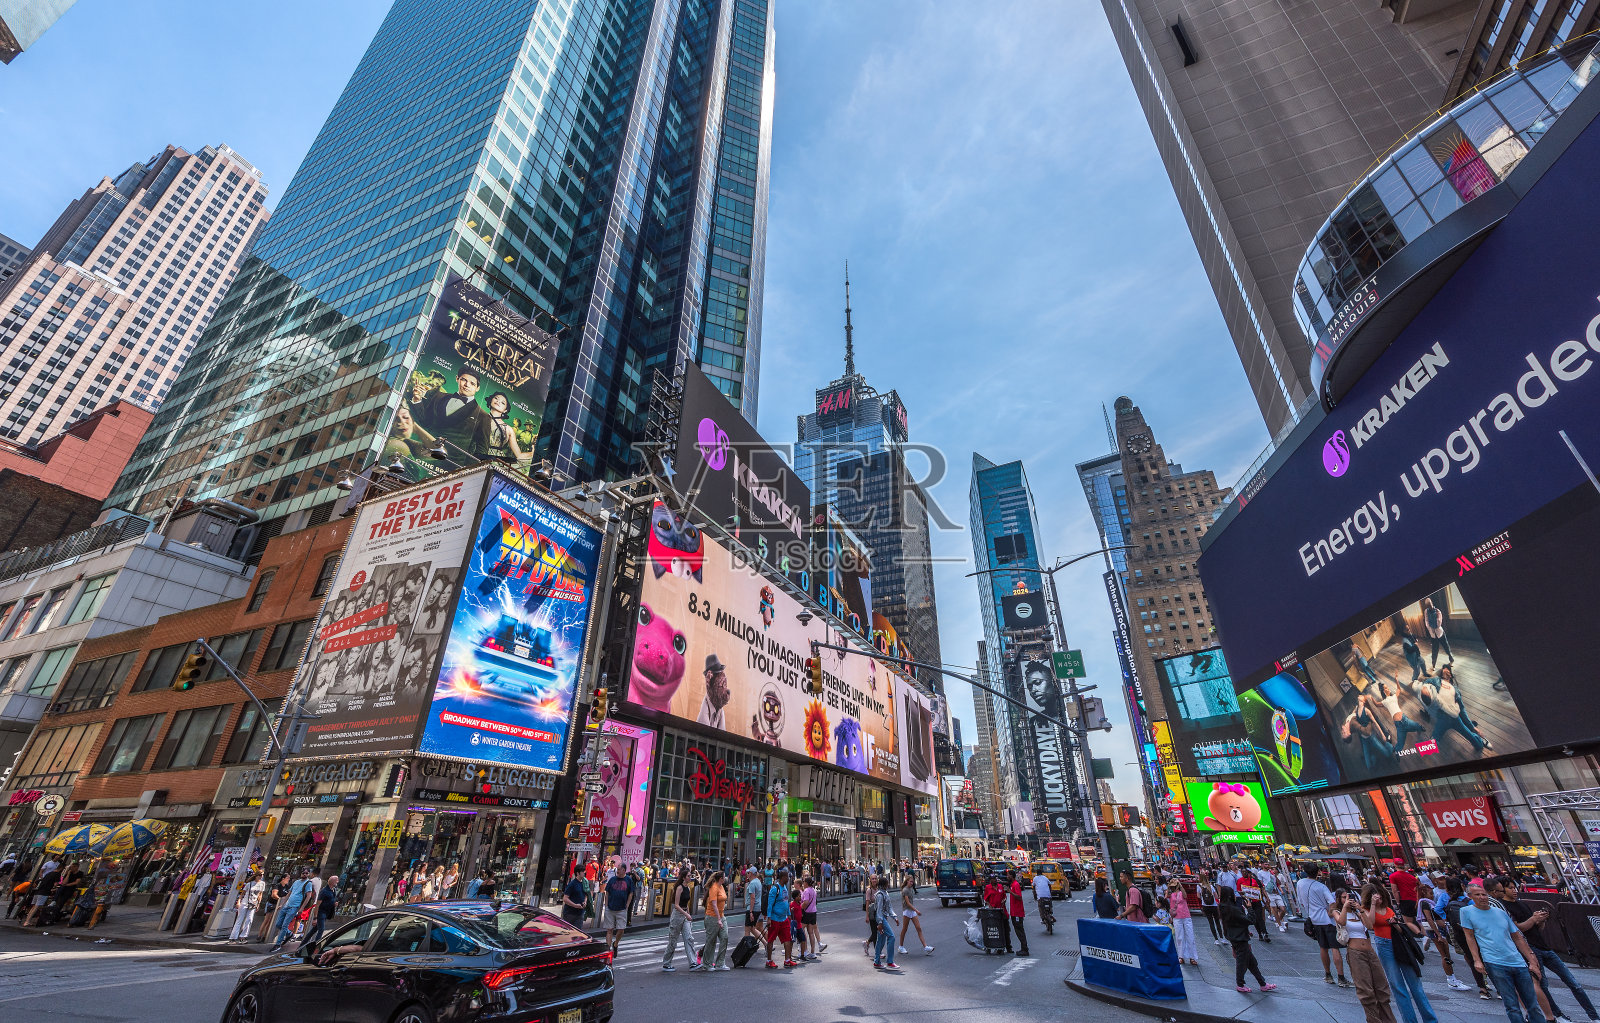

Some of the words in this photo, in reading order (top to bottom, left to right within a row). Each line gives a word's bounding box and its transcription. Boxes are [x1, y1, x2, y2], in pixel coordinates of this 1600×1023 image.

[1326, 276, 1378, 335] MARRIOTT
[1332, 291, 1378, 344] MARQUIS
[468, 299, 494, 318] GREAT
[494, 313, 508, 326] BIG
[508, 321, 547, 351] BROADWAY
[475, 310, 532, 348] EXTRAVAGANZA
[449, 311, 483, 346] THE
[486, 337, 545, 380] GREAT
[454, 339, 531, 388] GATSBY
[470, 364, 487, 375] NEW
[486, 373, 515, 392] MUSICAL
[819, 388, 851, 416] H&M
[1350, 341, 1450, 449] KRAKEN
[421, 460, 435, 470] THE
[382, 490, 434, 519] BEST
[434, 482, 464, 505] OF
[733, 454, 802, 539] KRAKEN
[1247, 477, 1267, 500] MARQUIS
[368, 515, 406, 541] THE
[407, 499, 466, 530] YEAR!
[498, 492, 533, 518] MUSICAL
[534, 513, 566, 538] THEATER
[566, 531, 595, 551] HISTORY
[513, 492, 527, 505] IT'S
[529, 500, 547, 516] TIME
[546, 510, 558, 520] TO
[558, 516, 587, 539] CHANGE
[497, 506, 587, 576] BACK
[815, 525, 825, 533] LG
[1298, 490, 1401, 577] Energy,
[500, 545, 521, 566] TO
[1471, 530, 1511, 557] MARRIOTT
[1475, 541, 1511, 566] MARQUIS
[491, 561, 517, 577] THE
[515, 556, 586, 595] FUTURE
[537, 587, 553, 597] THE
[552, 590, 583, 603] MUSICAL
[372, 605, 386, 615] WE
[320, 613, 366, 639] MERRILY
[327, 640, 351, 649] ROLL
[359, 628, 393, 642] ALONG
[1107, 574, 1143, 697] TetheredToCorruption.com
[687, 592, 712, 622] 8.3
[714, 608, 765, 651] MILLION
[768, 638, 811, 676] IMAGINA
[821, 669, 851, 696] FRIENDS
[851, 686, 865, 706] LIVE
[865, 694, 873, 710] IN
[747, 645, 775, 677] (YOU
[776, 669, 800, 690] JUST
[827, 690, 839, 710] SEE
[840, 697, 861, 721] THEM)
[308, 722, 349, 733] ENGAGEMENT
[348, 719, 378, 729] THROUGH
[379, 717, 395, 726] JULY
[398, 713, 420, 723] ONLY!
[443, 713, 480, 727] BROADWAY
[480, 721, 510, 733] BETWEEN
[521, 729, 534, 737] AND
[482, 736, 498, 746] WINTER
[498, 739, 515, 749] GARDEN
[515, 741, 533, 752] THEATRE
[862, 730, 875, 770] IF
[875, 746, 885, 758] NOW
[885, 750, 899, 764] PLAYING
[1194, 740, 1223, 752] QUIET
[1205, 749, 1224, 759] DAY
[1227, 747, 1250, 757] ONE
[290, 761, 374, 783] LUGGAGE
[421, 760, 476, 781] GIFTS
[488, 766, 557, 791] LUGGAGE
[425, 792, 442, 800] Apple
[446, 793, 469, 803] Nikon
[490, 784, 507, 795] NY
[808, 766, 856, 805] FOREVER
[293, 796, 317, 804] SONY
[472, 795, 499, 805] Canon
[503, 798, 529, 806] SONY
[390, 821, 401, 845] ATM
[1086, 946, 1107, 960] TIMES
[1107, 951, 1133, 965] SQUARE
